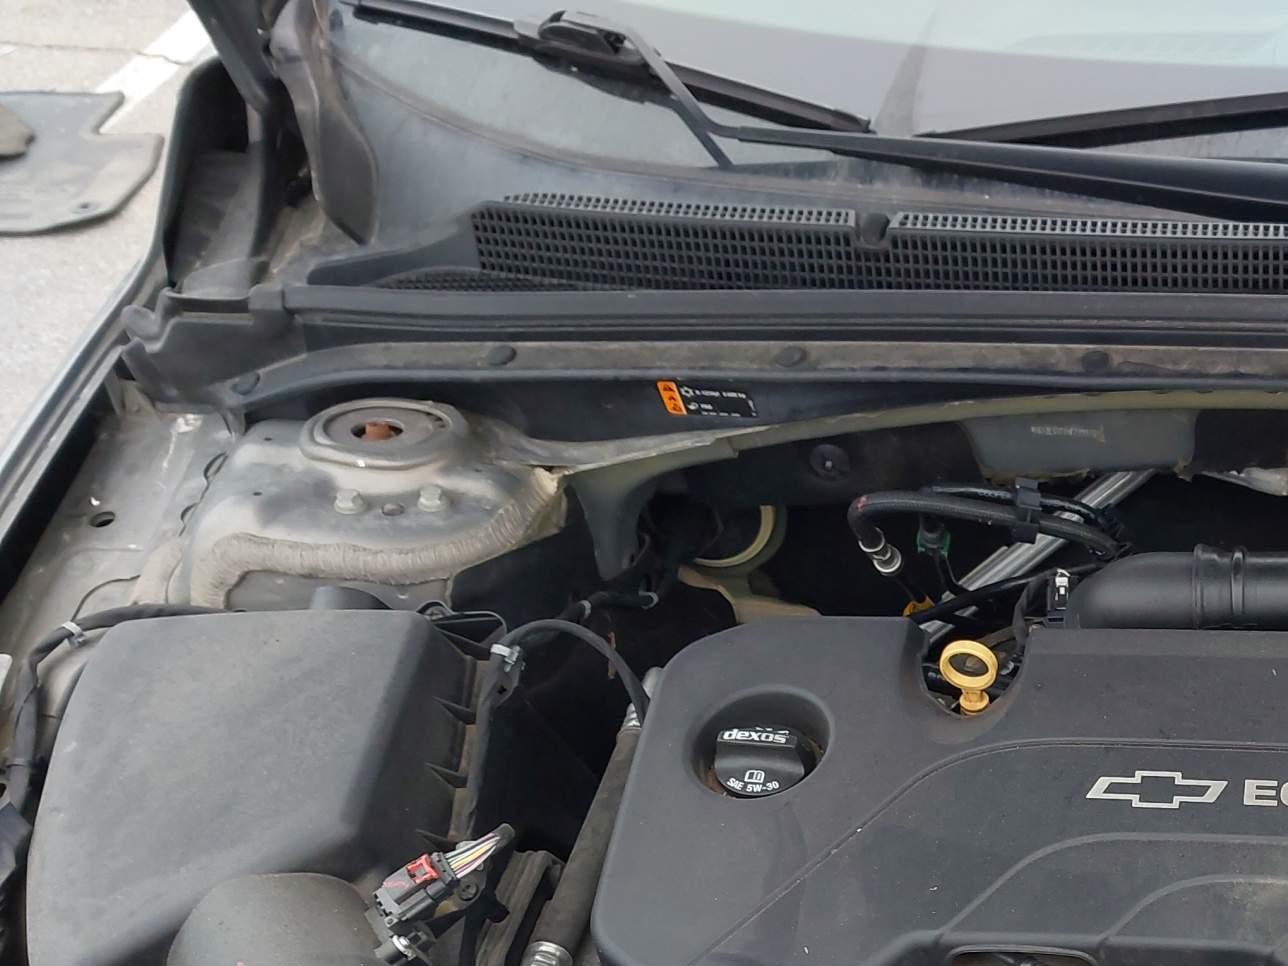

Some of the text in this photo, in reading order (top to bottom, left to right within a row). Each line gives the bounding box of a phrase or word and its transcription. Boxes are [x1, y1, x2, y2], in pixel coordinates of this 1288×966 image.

[723, 729, 787, 744] dexos
[727, 777, 780, 793] SAE 5W-30
